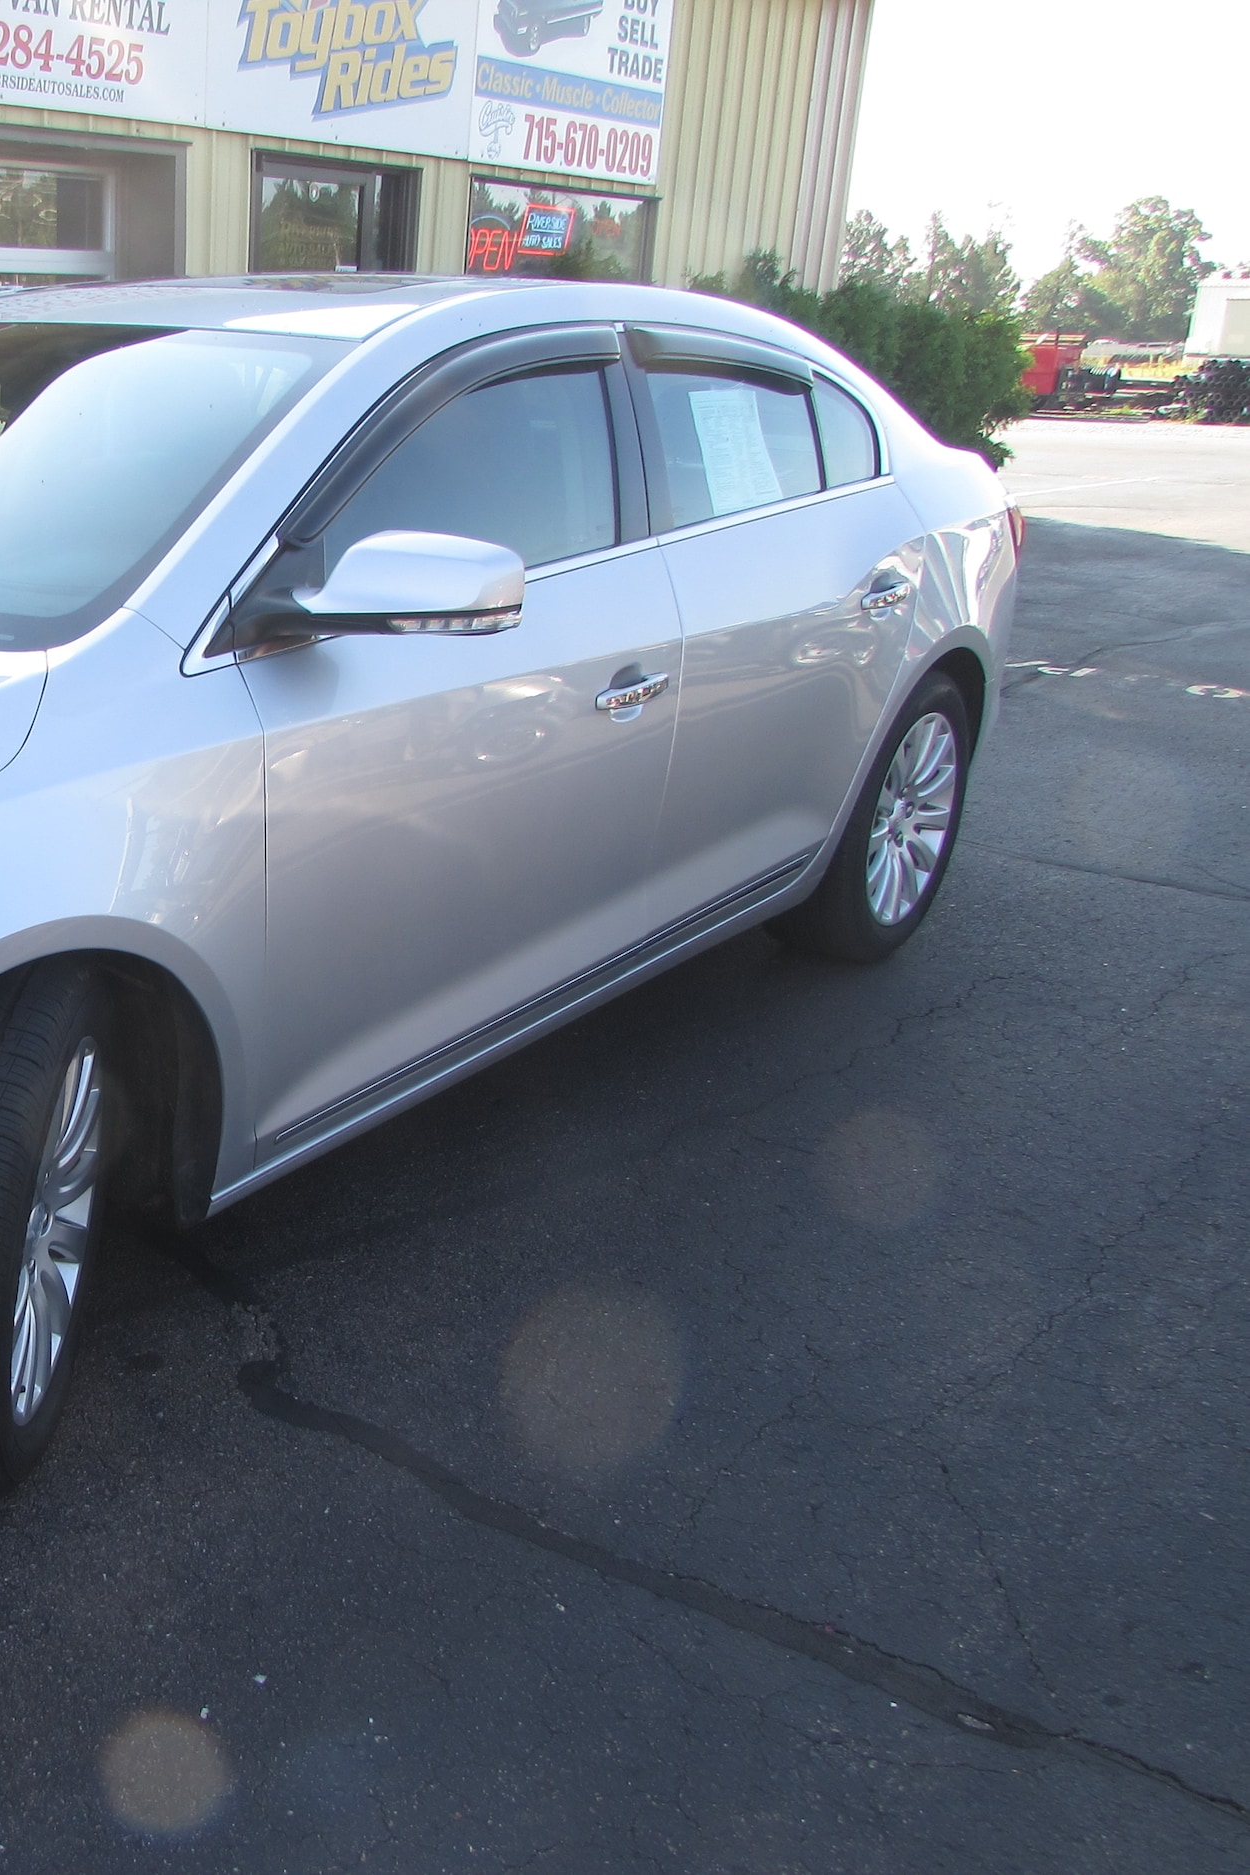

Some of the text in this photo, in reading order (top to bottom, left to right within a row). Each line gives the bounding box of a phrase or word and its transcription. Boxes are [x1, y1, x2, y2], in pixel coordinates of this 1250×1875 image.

[69, 0, 171, 36] RENTAL
[244, 0, 425, 73] Toybox
[617, 15, 659, 50] SELL
[320, 43, 456, 113] Rides
[607, 47, 665, 84] TRADE
[477, 62, 661, 122] Classic Muscle Collector
[523, 113, 653, 177] 715-670-0209
[541, 235, 563, 249] SALES
